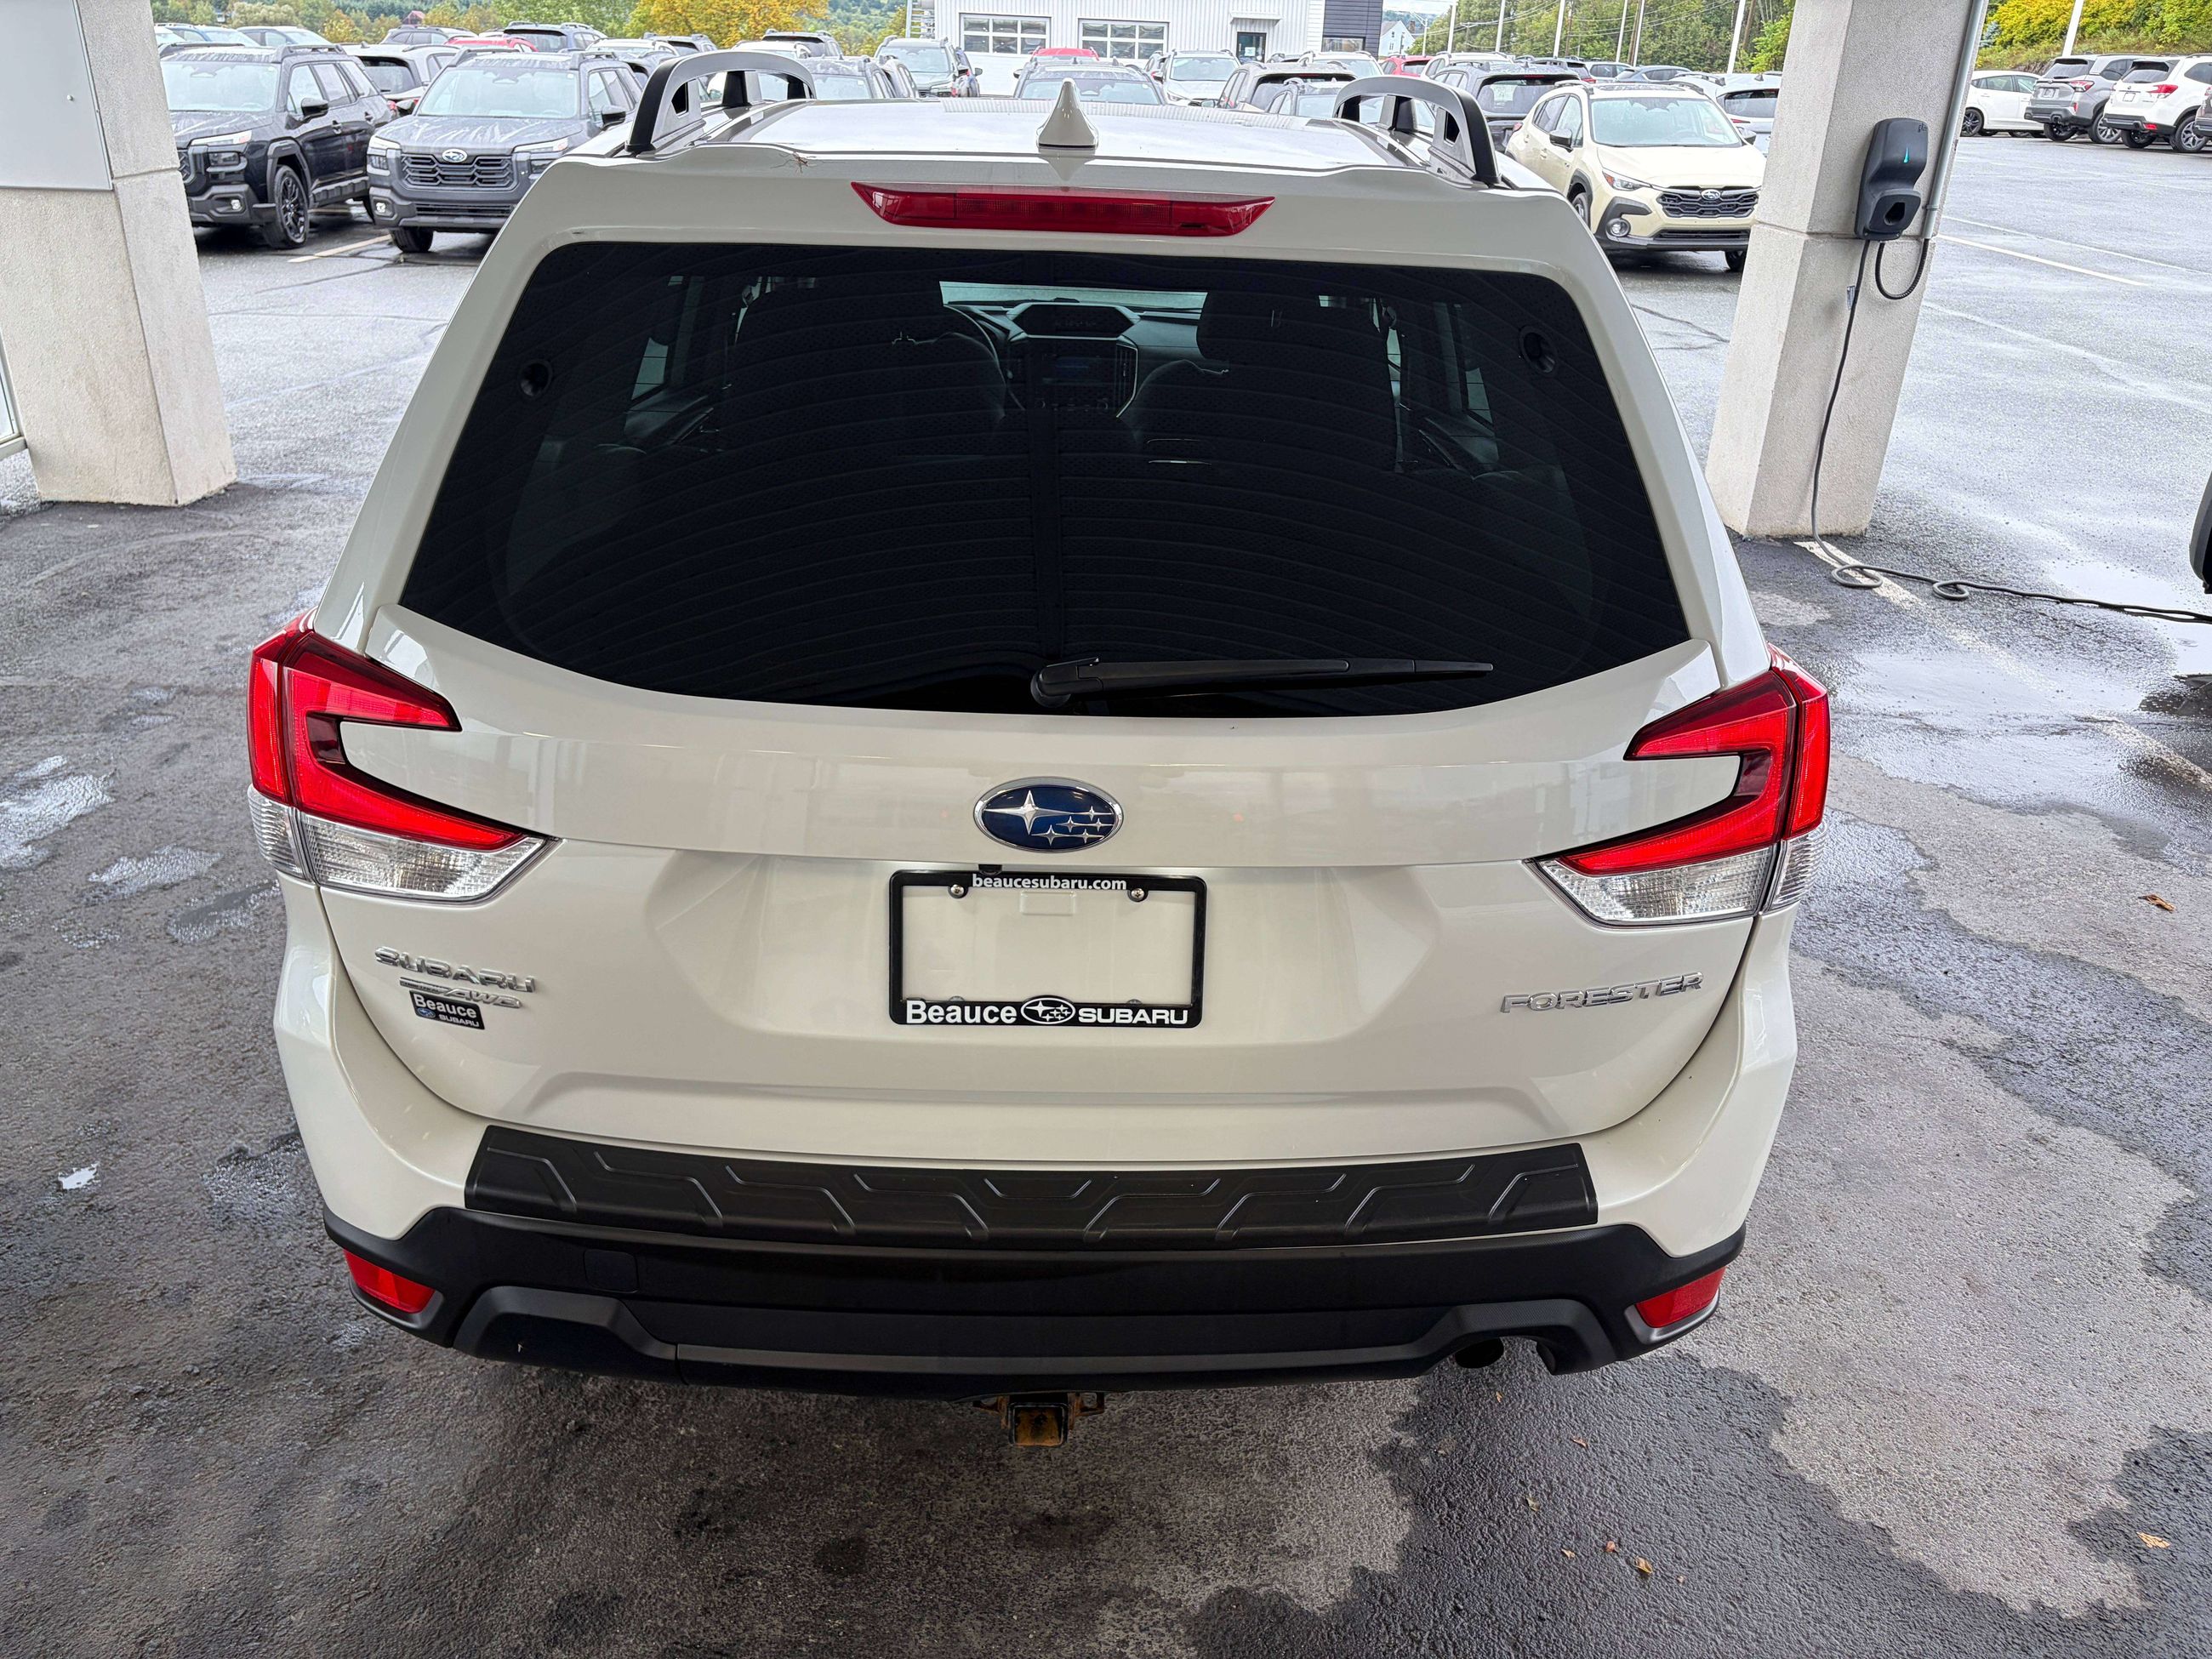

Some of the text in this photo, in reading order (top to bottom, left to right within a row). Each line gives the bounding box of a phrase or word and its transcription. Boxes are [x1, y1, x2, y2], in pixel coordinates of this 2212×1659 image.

[972, 873, 1127, 891] beaucesubaru.com
[374, 945, 536, 993] SUBARU
[443, 987, 523, 1009] AWD
[1499, 971, 1704, 1013] FORESTER
[413, 993, 478, 1019] Beauce
[905, 1000, 1189, 1025] Beauce SUBARU
[438, 1013, 480, 1028] SUBARU
